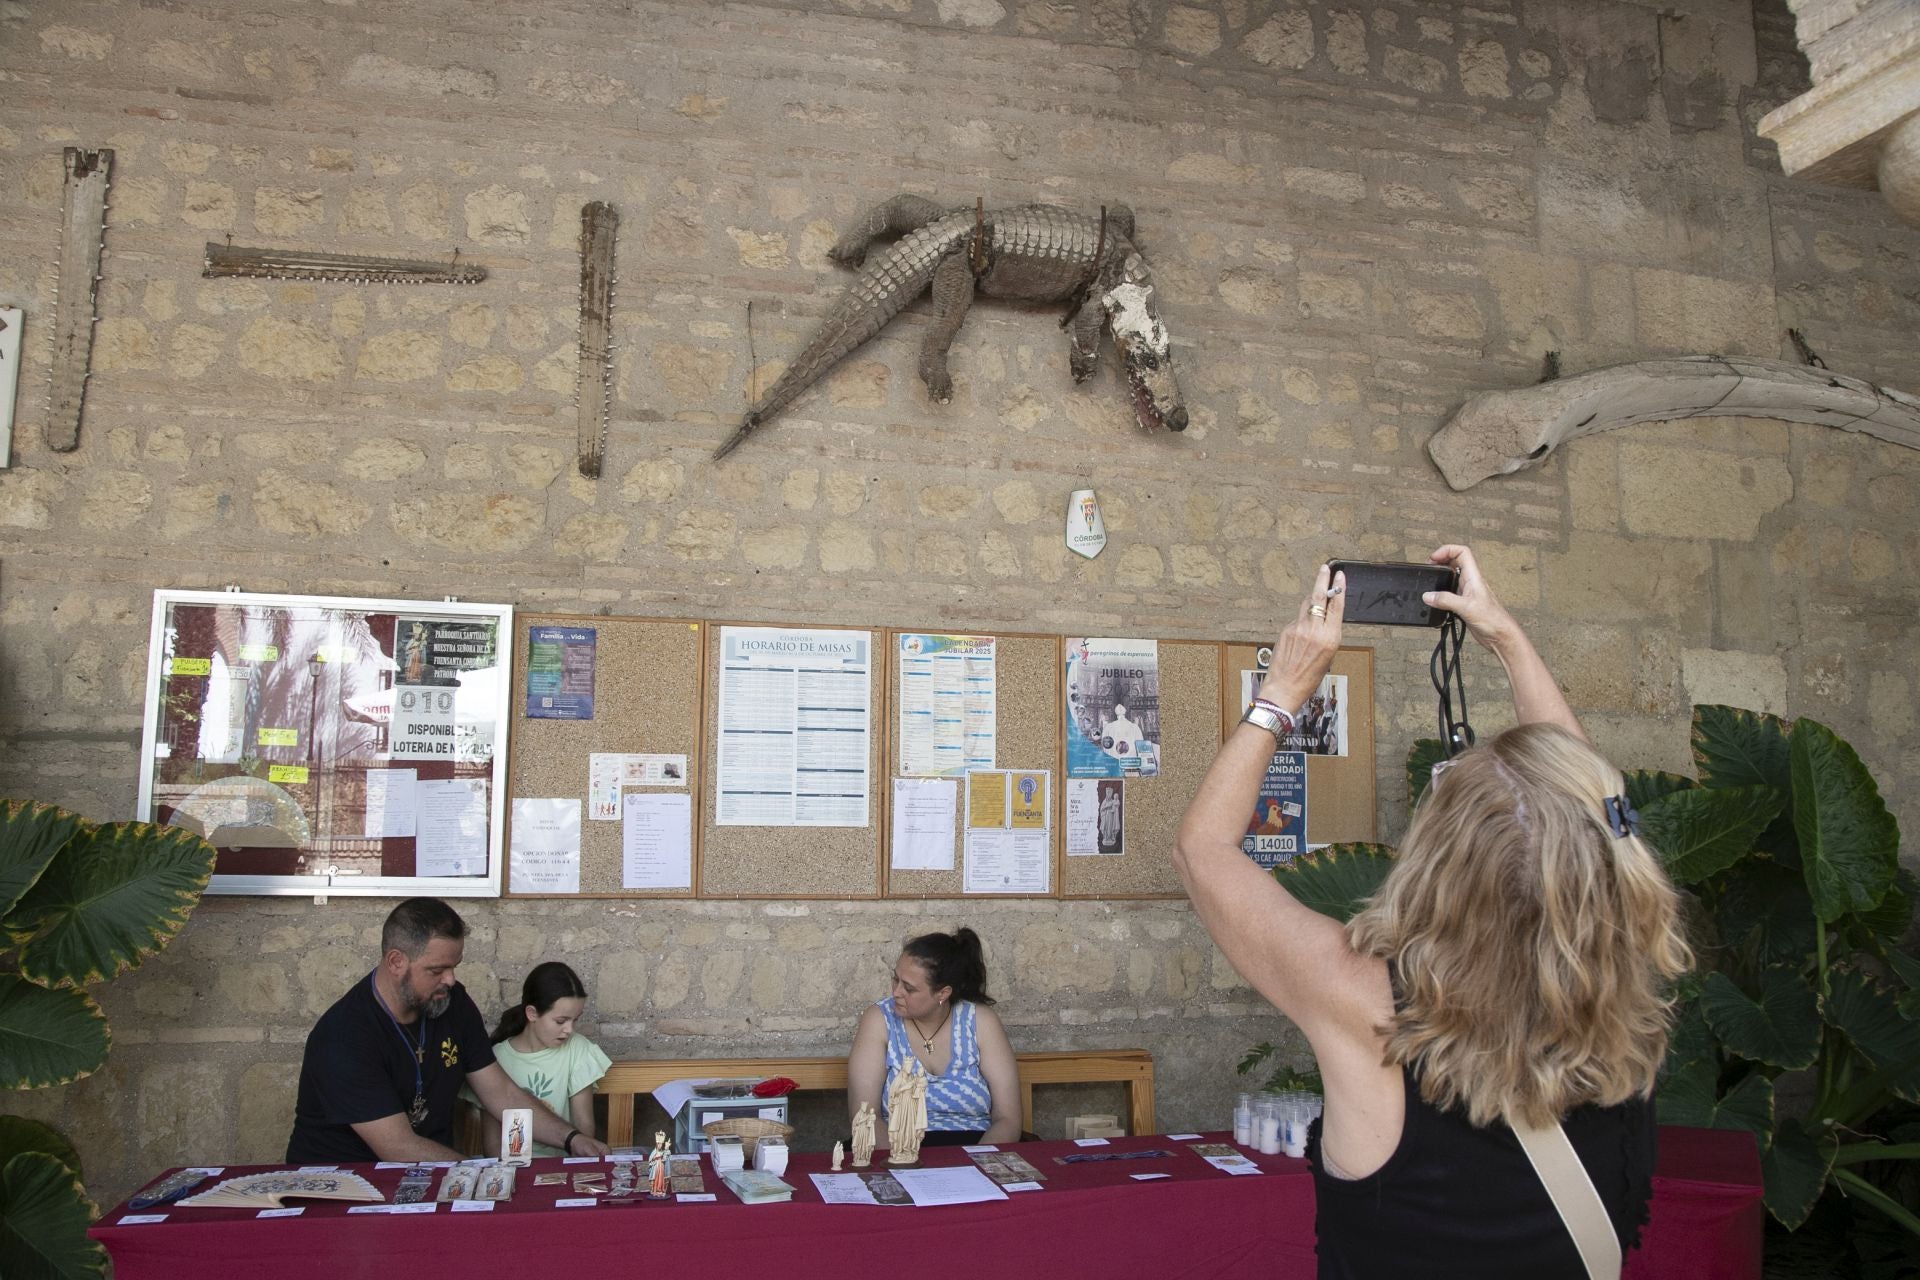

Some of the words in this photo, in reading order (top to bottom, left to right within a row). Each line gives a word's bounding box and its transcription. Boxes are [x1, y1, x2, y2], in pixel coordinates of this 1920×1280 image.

[435, 630, 462, 639] PARROQUIA
[434, 644, 455, 652] NUESTRA
[741, 640, 796, 652] HORARIO
[800, 642, 815, 652] DE
[818, 643, 852, 653] MISAS
[434, 657, 462, 665] FUENSANTA
[1100, 668, 1144, 678] JUBILEO
[408, 724, 463, 736] DISPONIBLE
[1282, 737, 1319, 747] ONDAD
[393, 741, 433, 754] LOTERIA
[436, 742, 448, 754] DE
[1266, 765, 1304, 774] ONDAD!
[1260, 838, 1293, 850] 14010
[1261, 853, 1271, 861] CAE
